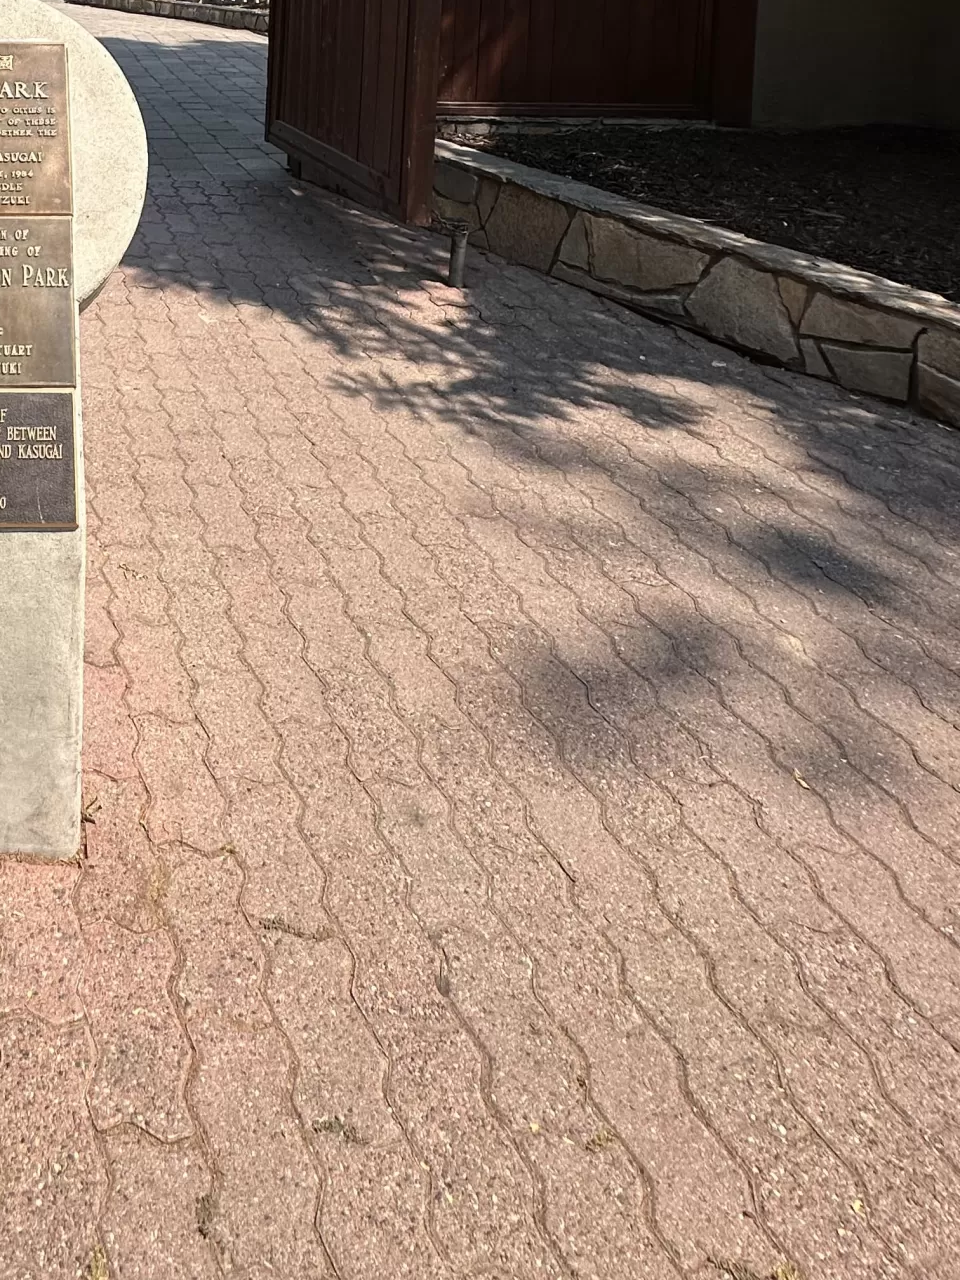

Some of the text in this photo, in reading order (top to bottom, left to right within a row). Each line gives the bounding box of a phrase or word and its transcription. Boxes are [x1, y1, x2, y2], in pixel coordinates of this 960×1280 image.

[12, 107, 42, 116] CITIES
[46, 107, 56, 116] IS
[8, 118, 20, 127] OF
[24, 118, 56, 127] THESE
[38, 129, 57, 137] THE
[15, 229, 29, 240] OF
[28, 246, 42, 257] OF
[22, 264, 70, 287] PARK
[7, 426, 57, 440] BETWEEN
[18, 444, 63, 459] KASUGAI
